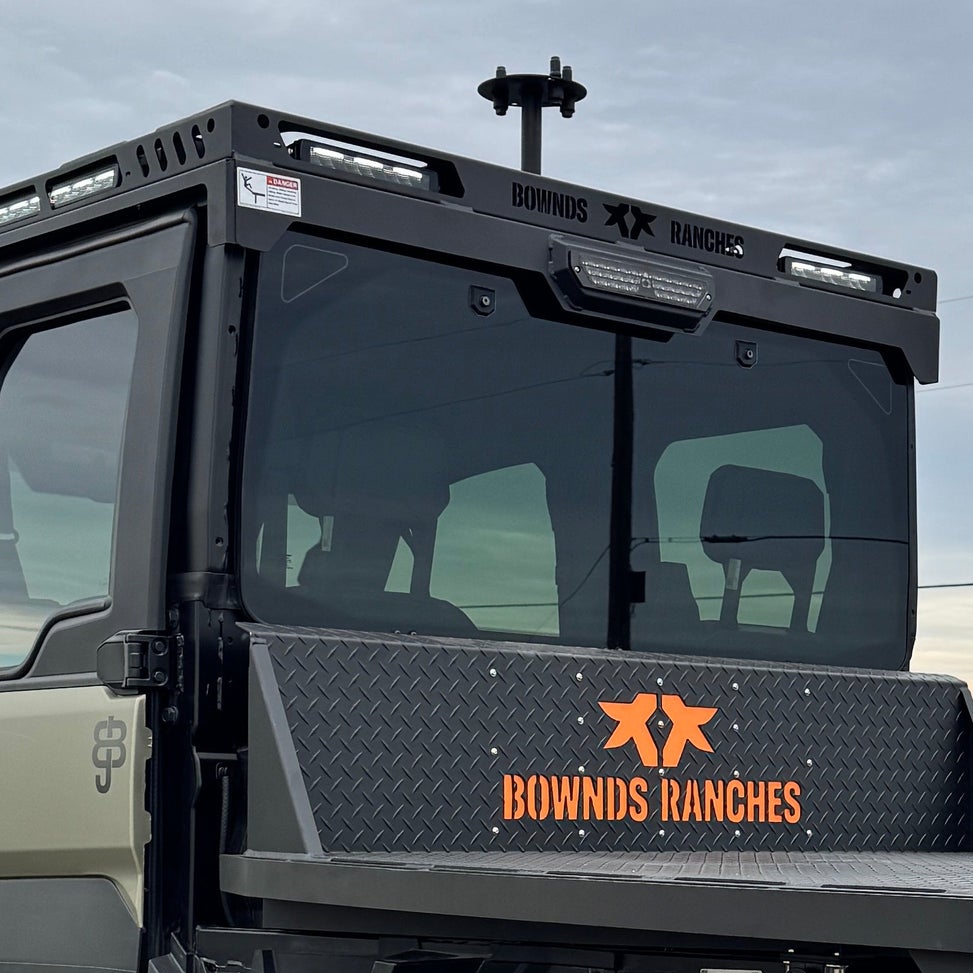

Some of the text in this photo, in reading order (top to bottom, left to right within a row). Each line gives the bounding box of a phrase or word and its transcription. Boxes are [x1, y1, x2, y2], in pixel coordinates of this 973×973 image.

[272, 178, 298, 191] DANGER
[511, 181, 745, 259] BOWNDS RANCHES
[502, 773, 801, 823] BOWNDS RANCHES
